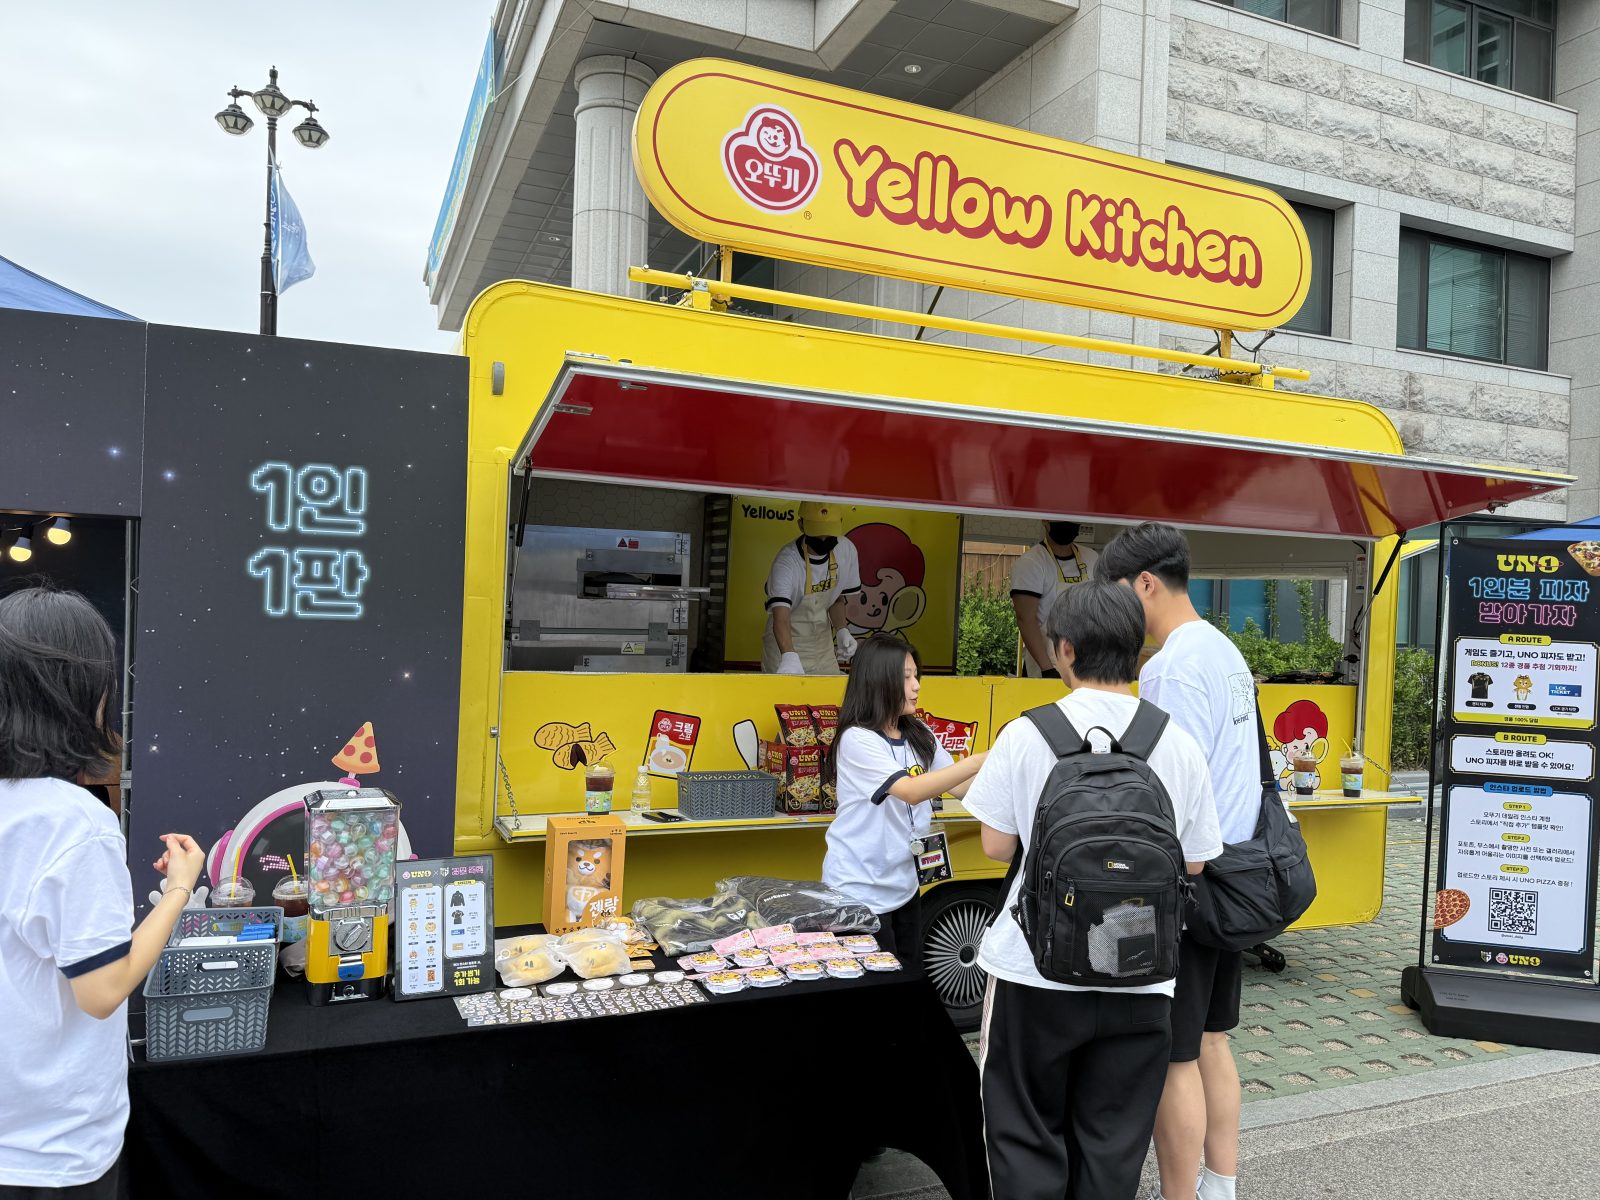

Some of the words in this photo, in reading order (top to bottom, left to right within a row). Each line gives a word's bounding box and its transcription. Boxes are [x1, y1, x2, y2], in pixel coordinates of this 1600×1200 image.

[744, 158, 800, 193] 오뚜기
[834, 138, 1052, 249] Yellow
[1065, 188, 1262, 289] Kitchen
[251, 462, 367, 535] 1인
[741, 504, 795, 521] Yellows
[1497, 554, 1560, 573] UNO
[249, 547, 368, 618] 1판
[1468, 576, 1531, 600] 1인분
[1539, 579, 1590, 602] 피자
[1515, 636, 1542, 644] ROUTE
[1464, 648, 1488, 657] 게임도
[1489, 650, 1516, 659] 즐기고,
[1517, 651, 1538, 659] UNO
[1540, 652, 1564, 661] 피자도
[1566, 653, 1586, 662] 받고!
[673, 721, 694, 733] 크림
[678, 732, 692, 741] 스프
[1485, 749, 1514, 757] 스토리만
[1515, 750, 1537, 759] 올려도
[1538, 751, 1554, 759] OK!
[1465, 757, 1485, 765] UNO
[1485, 757, 1507, 766] 피자를
[1508, 759, 1523, 768] 바로
[1524, 760, 1539, 769] 받을
[1540, 761, 1548, 769] 수
[1549, 762, 1575, 771] 있어요!
[1489, 784, 1510, 792] 인스타
[1508, 954, 1541, 967] UNO
